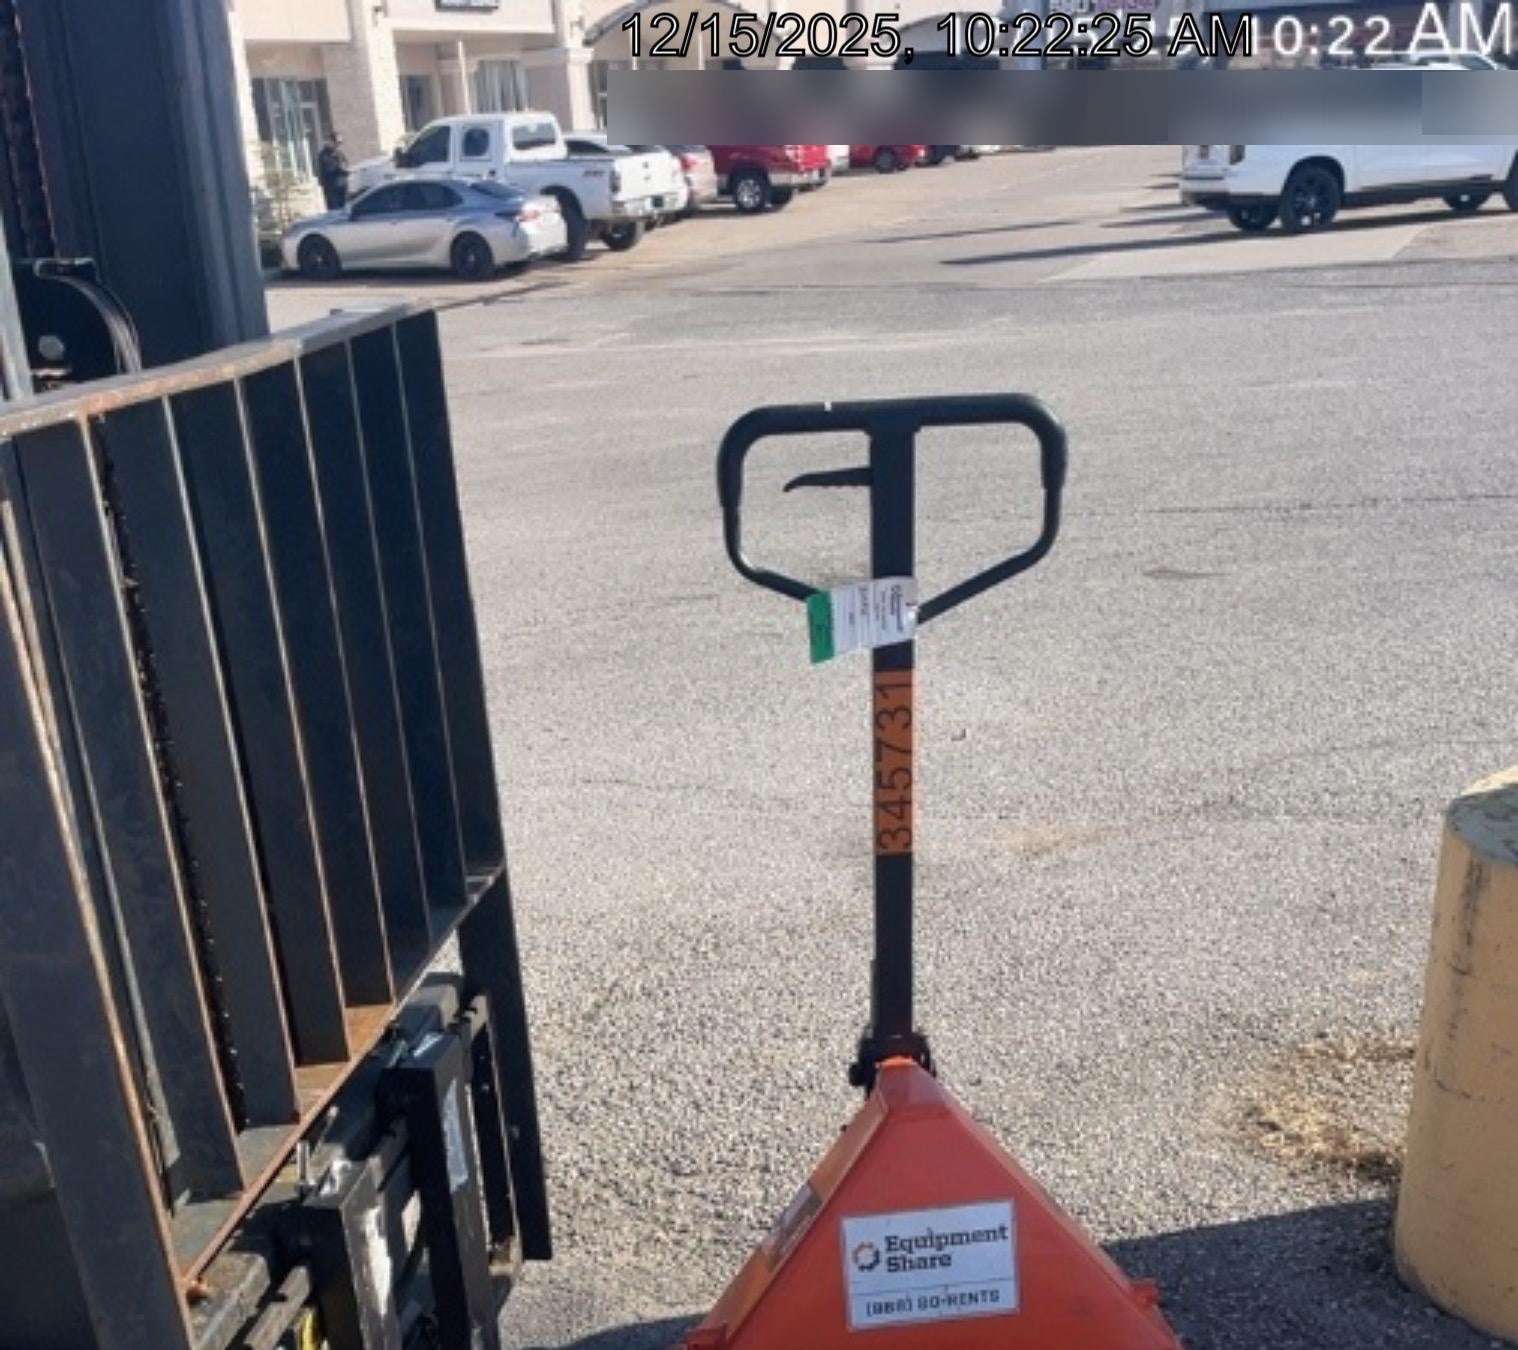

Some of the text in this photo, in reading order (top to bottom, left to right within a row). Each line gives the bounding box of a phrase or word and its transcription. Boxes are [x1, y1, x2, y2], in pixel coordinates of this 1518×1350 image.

[877, 684, 913, 850] 345731
[884, 1225, 1009, 1253] Equipment
[886, 1253, 952, 1273] Share
